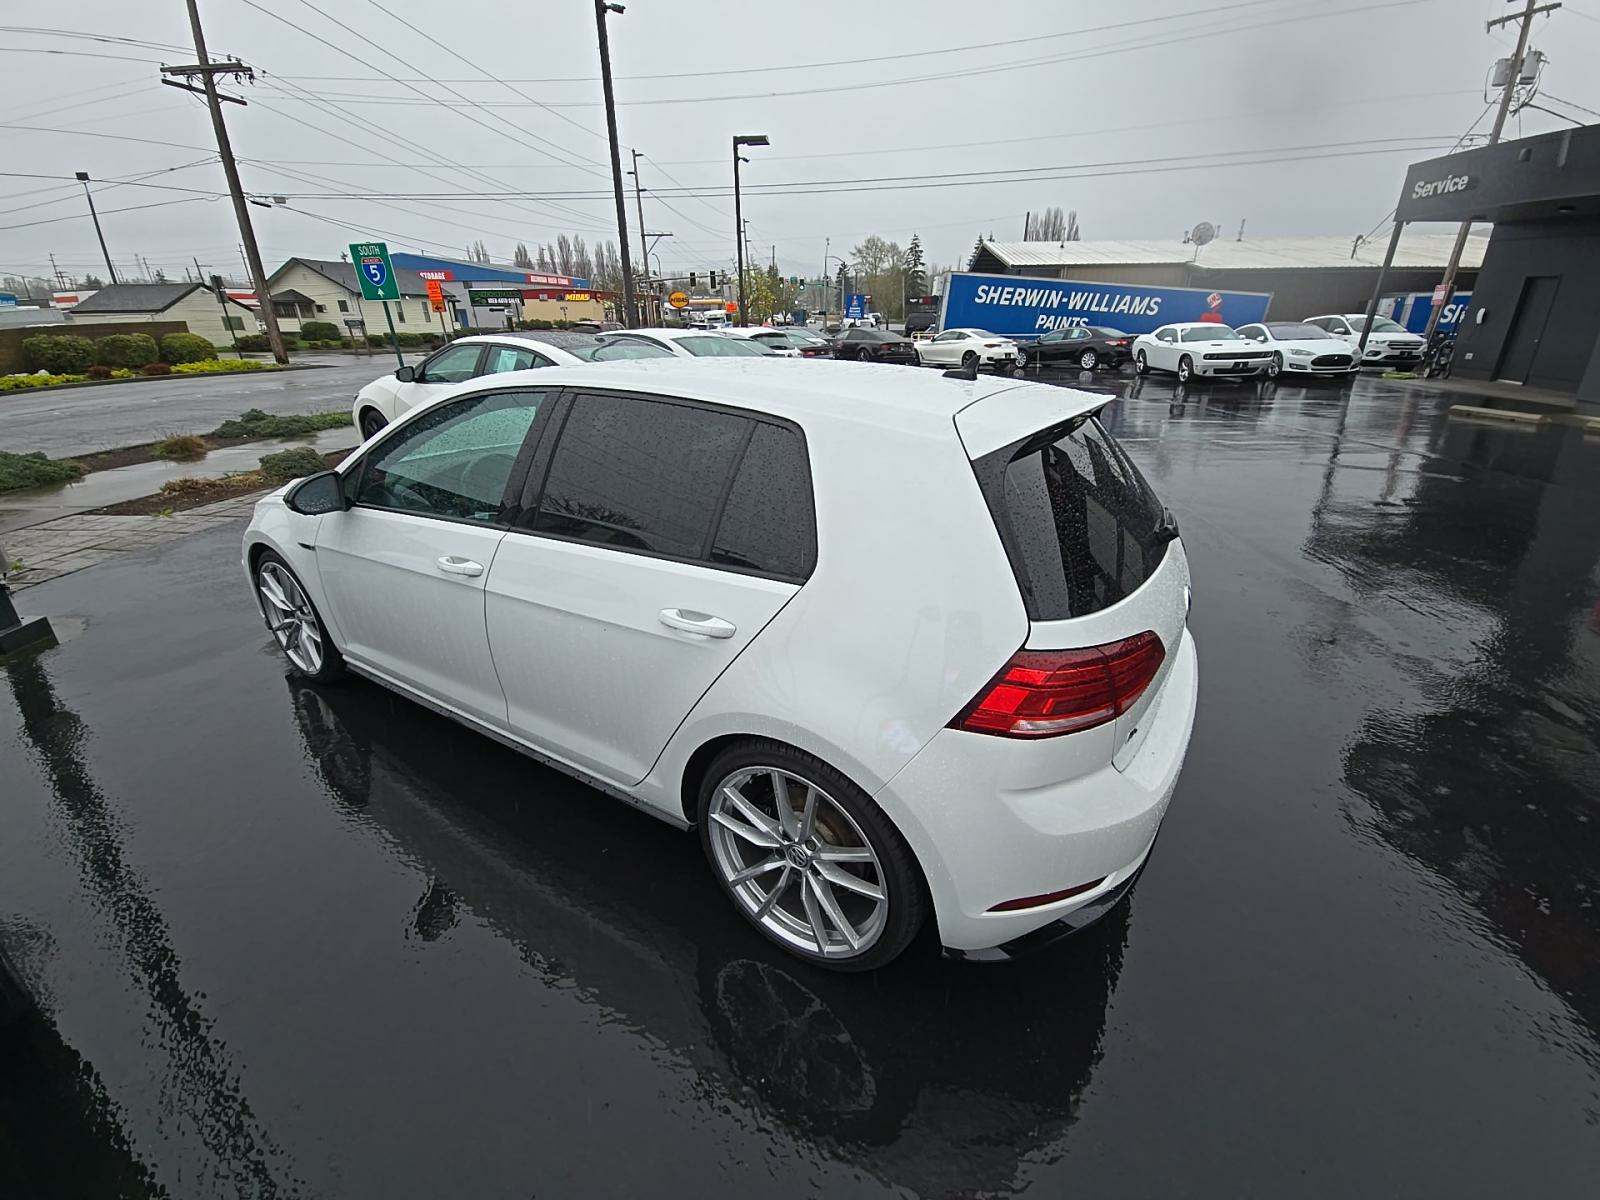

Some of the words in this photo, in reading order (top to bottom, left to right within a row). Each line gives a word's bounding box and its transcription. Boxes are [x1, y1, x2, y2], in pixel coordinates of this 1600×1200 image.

[1412, 174, 1469, 199] Service
[357, 245, 381, 256] SOUTH
[369, 264, 381, 281] 5
[420, 271, 446, 280] STORAGE
[565, 293, 591, 301] MIDAS
[974, 285, 1162, 316] SHERWIN-WILLIAMS
[1035, 314, 1089, 330] PAINTS
